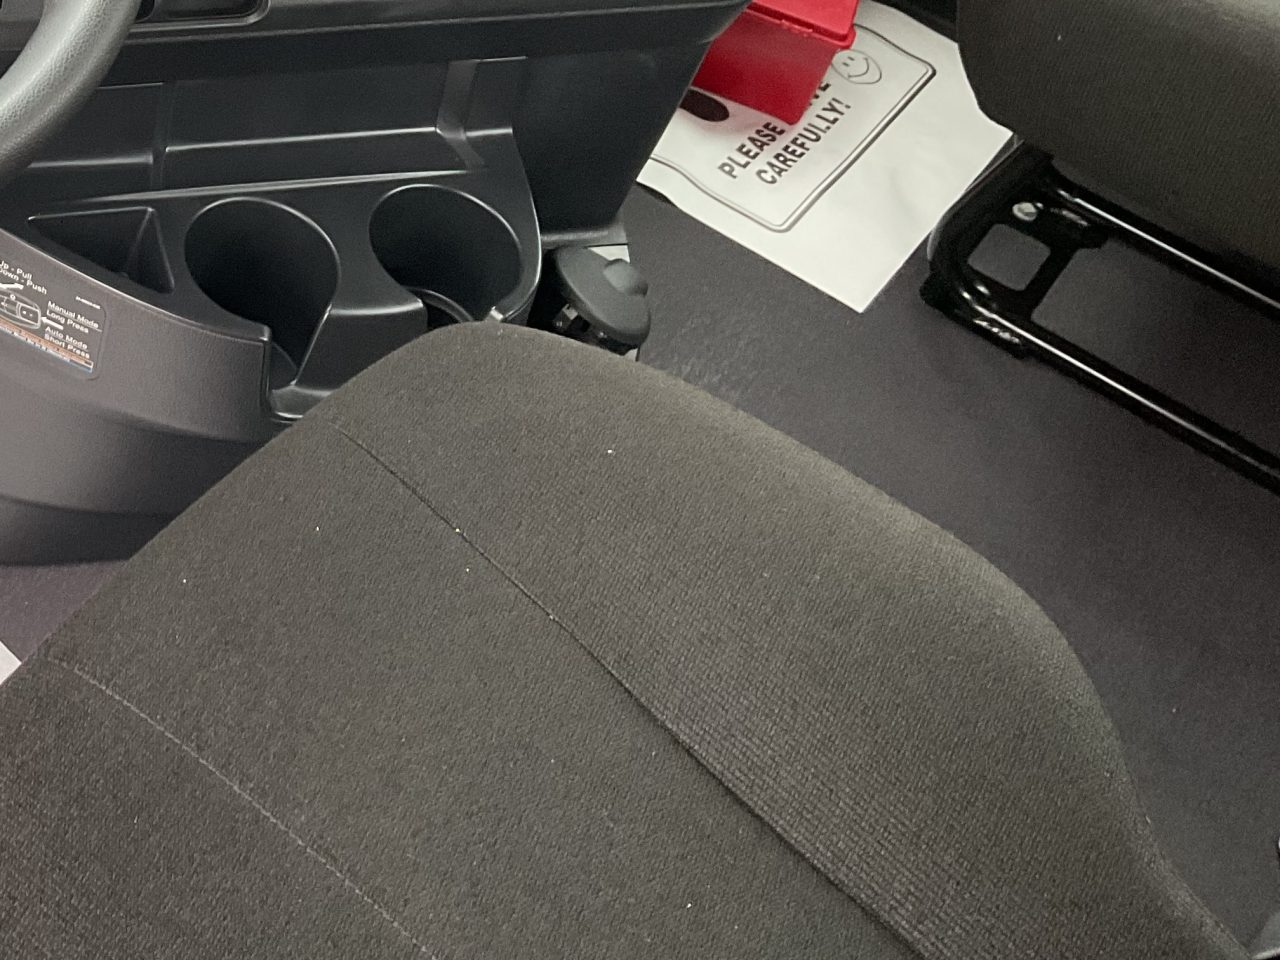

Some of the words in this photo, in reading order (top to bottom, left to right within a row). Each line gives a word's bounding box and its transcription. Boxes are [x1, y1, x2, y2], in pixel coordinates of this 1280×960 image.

[718, 122, 786, 179] PLEASE
[756, 97, 851, 185] CAREFULLY!
[17, 268, 32, 280] Pull
[27, 280, 47, 295] Push
[47, 309, 66, 324] Long
[67, 318, 89, 333] Press
[48, 301, 76, 318] Manual
[77, 314, 99, 329] Mode
[45, 326, 64, 338] Auto
[66, 335, 87, 350] Mode
[45, 333, 65, 348] Short
[67, 344, 90, 359] Press
